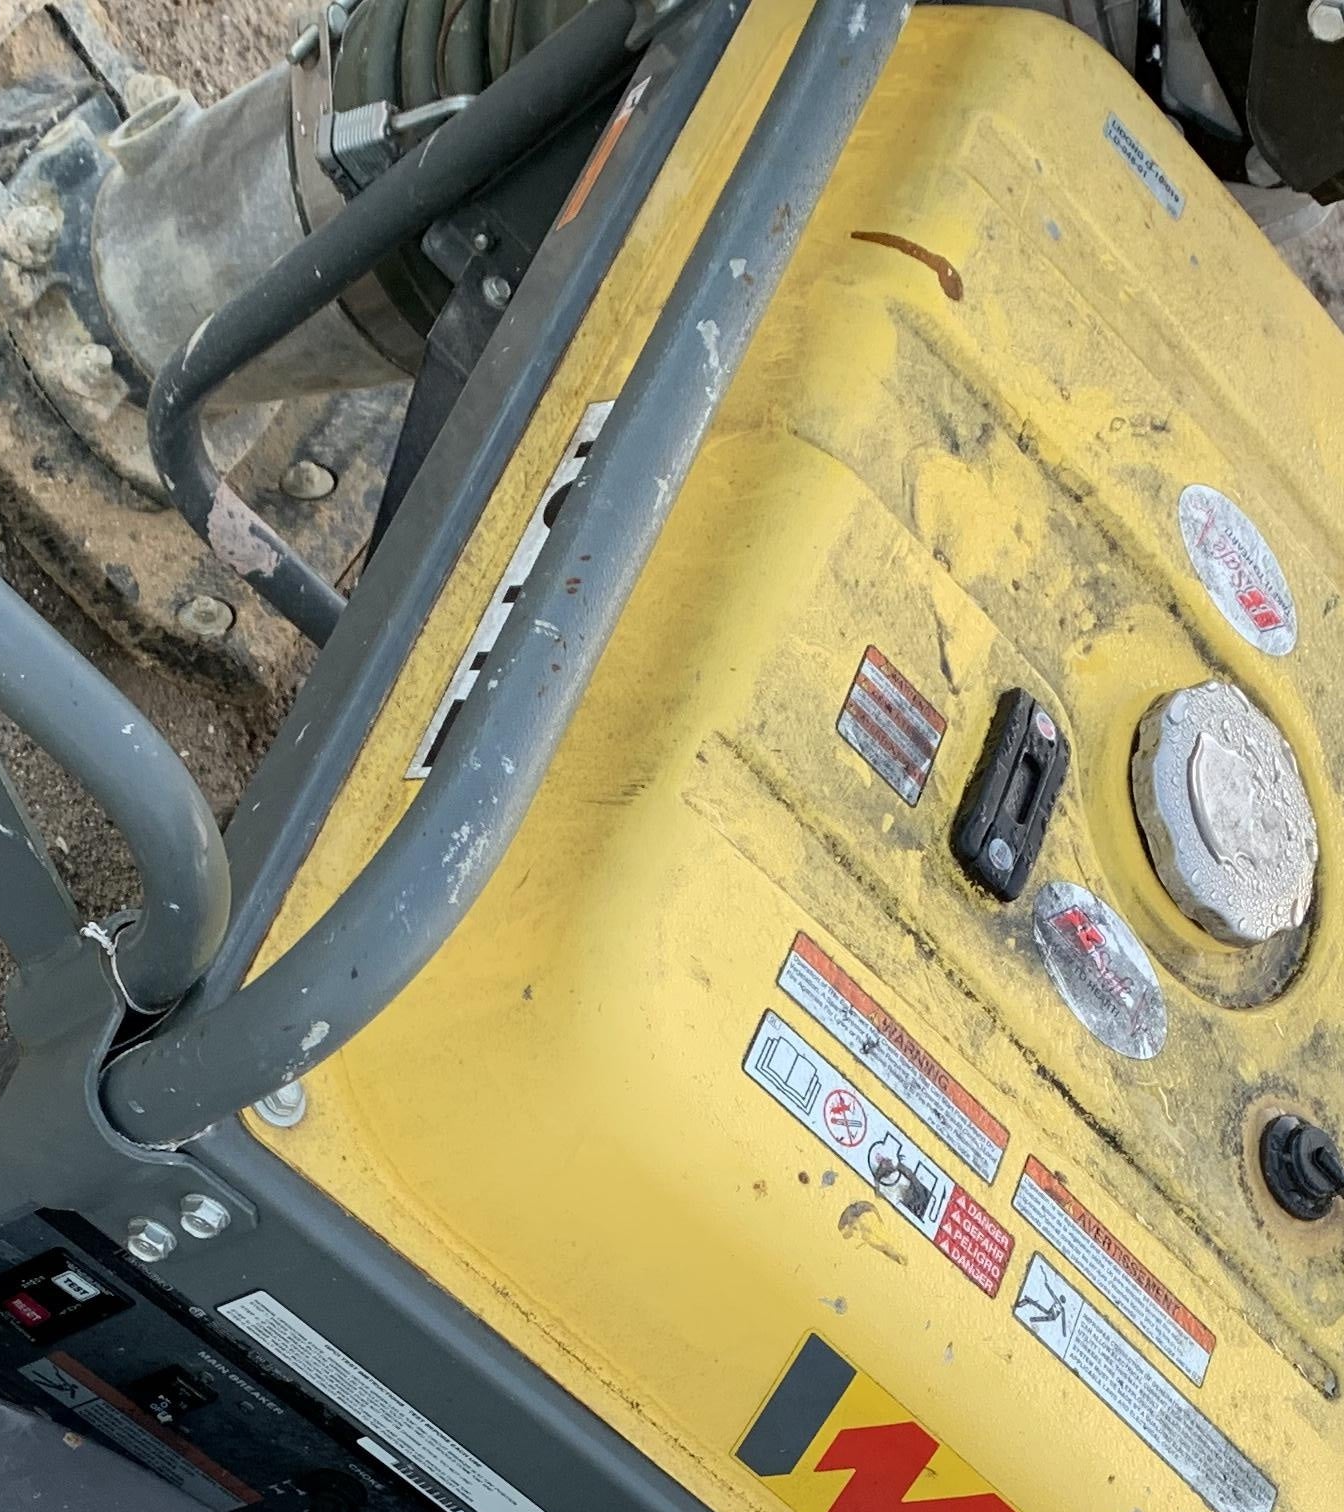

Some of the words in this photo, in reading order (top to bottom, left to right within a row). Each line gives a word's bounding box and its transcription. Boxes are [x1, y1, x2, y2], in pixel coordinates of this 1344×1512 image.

[880, 1018, 950, 1092] WARNING
[961, 1217, 1004, 1263] GEFAHR
[966, 1203, 1009, 1249] DANGER
[950, 1246, 994, 1294] DANGER
[952, 1229, 1000, 1280] PELIGRO
[1076, 1209, 1179, 1317] AVERTISSEMENT
[64, 1278, 89, 1296] TEST
[198, 1351, 230, 1374] MAIN
[228, 1374, 284, 1415] BREAKER
